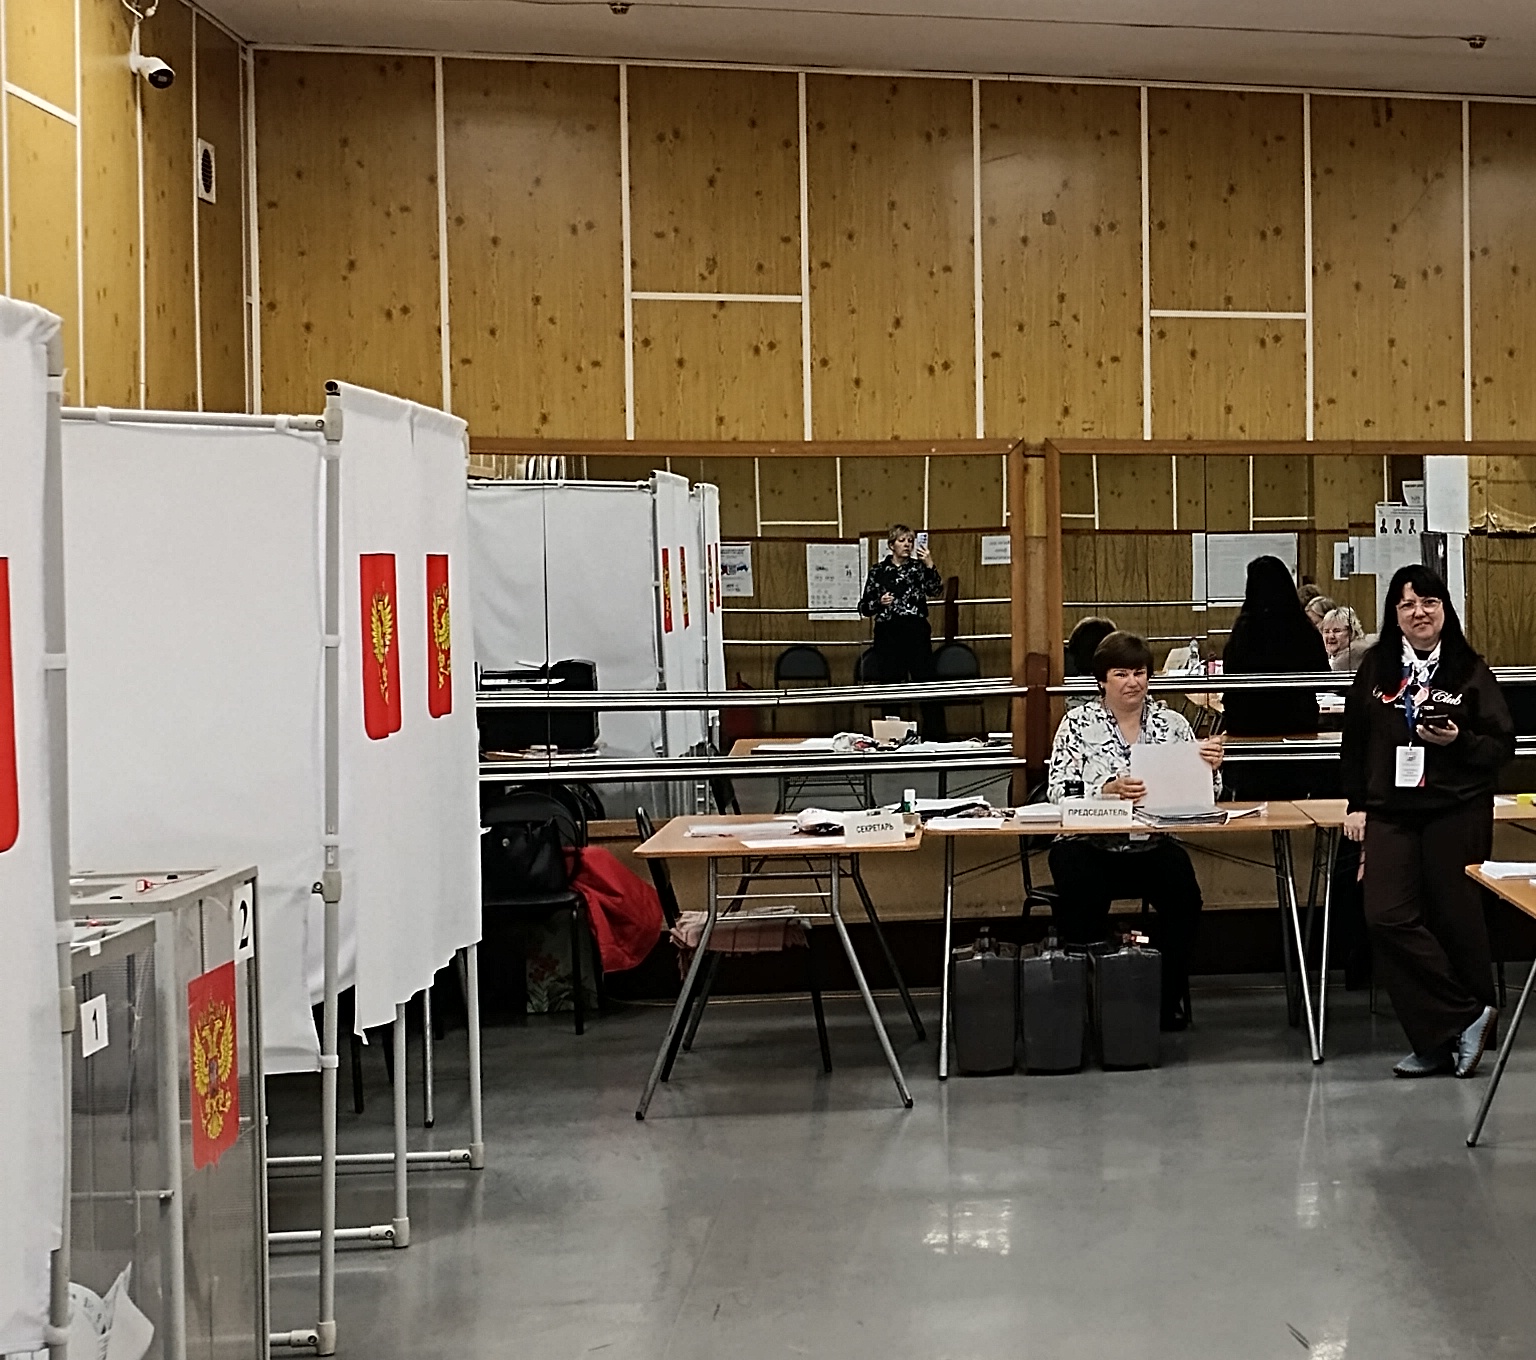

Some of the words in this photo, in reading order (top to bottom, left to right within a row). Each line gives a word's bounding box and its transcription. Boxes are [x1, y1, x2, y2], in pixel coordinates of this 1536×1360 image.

[1431, 689, 1462, 705] Club
[1068, 808, 1128, 816] ПРЕДСЕДАТЕЛЬ
[856, 823, 894, 833] СЕКРЕТАРЬ
[239, 900, 249, 950] 2
[92, 1008, 98, 1040] 1
